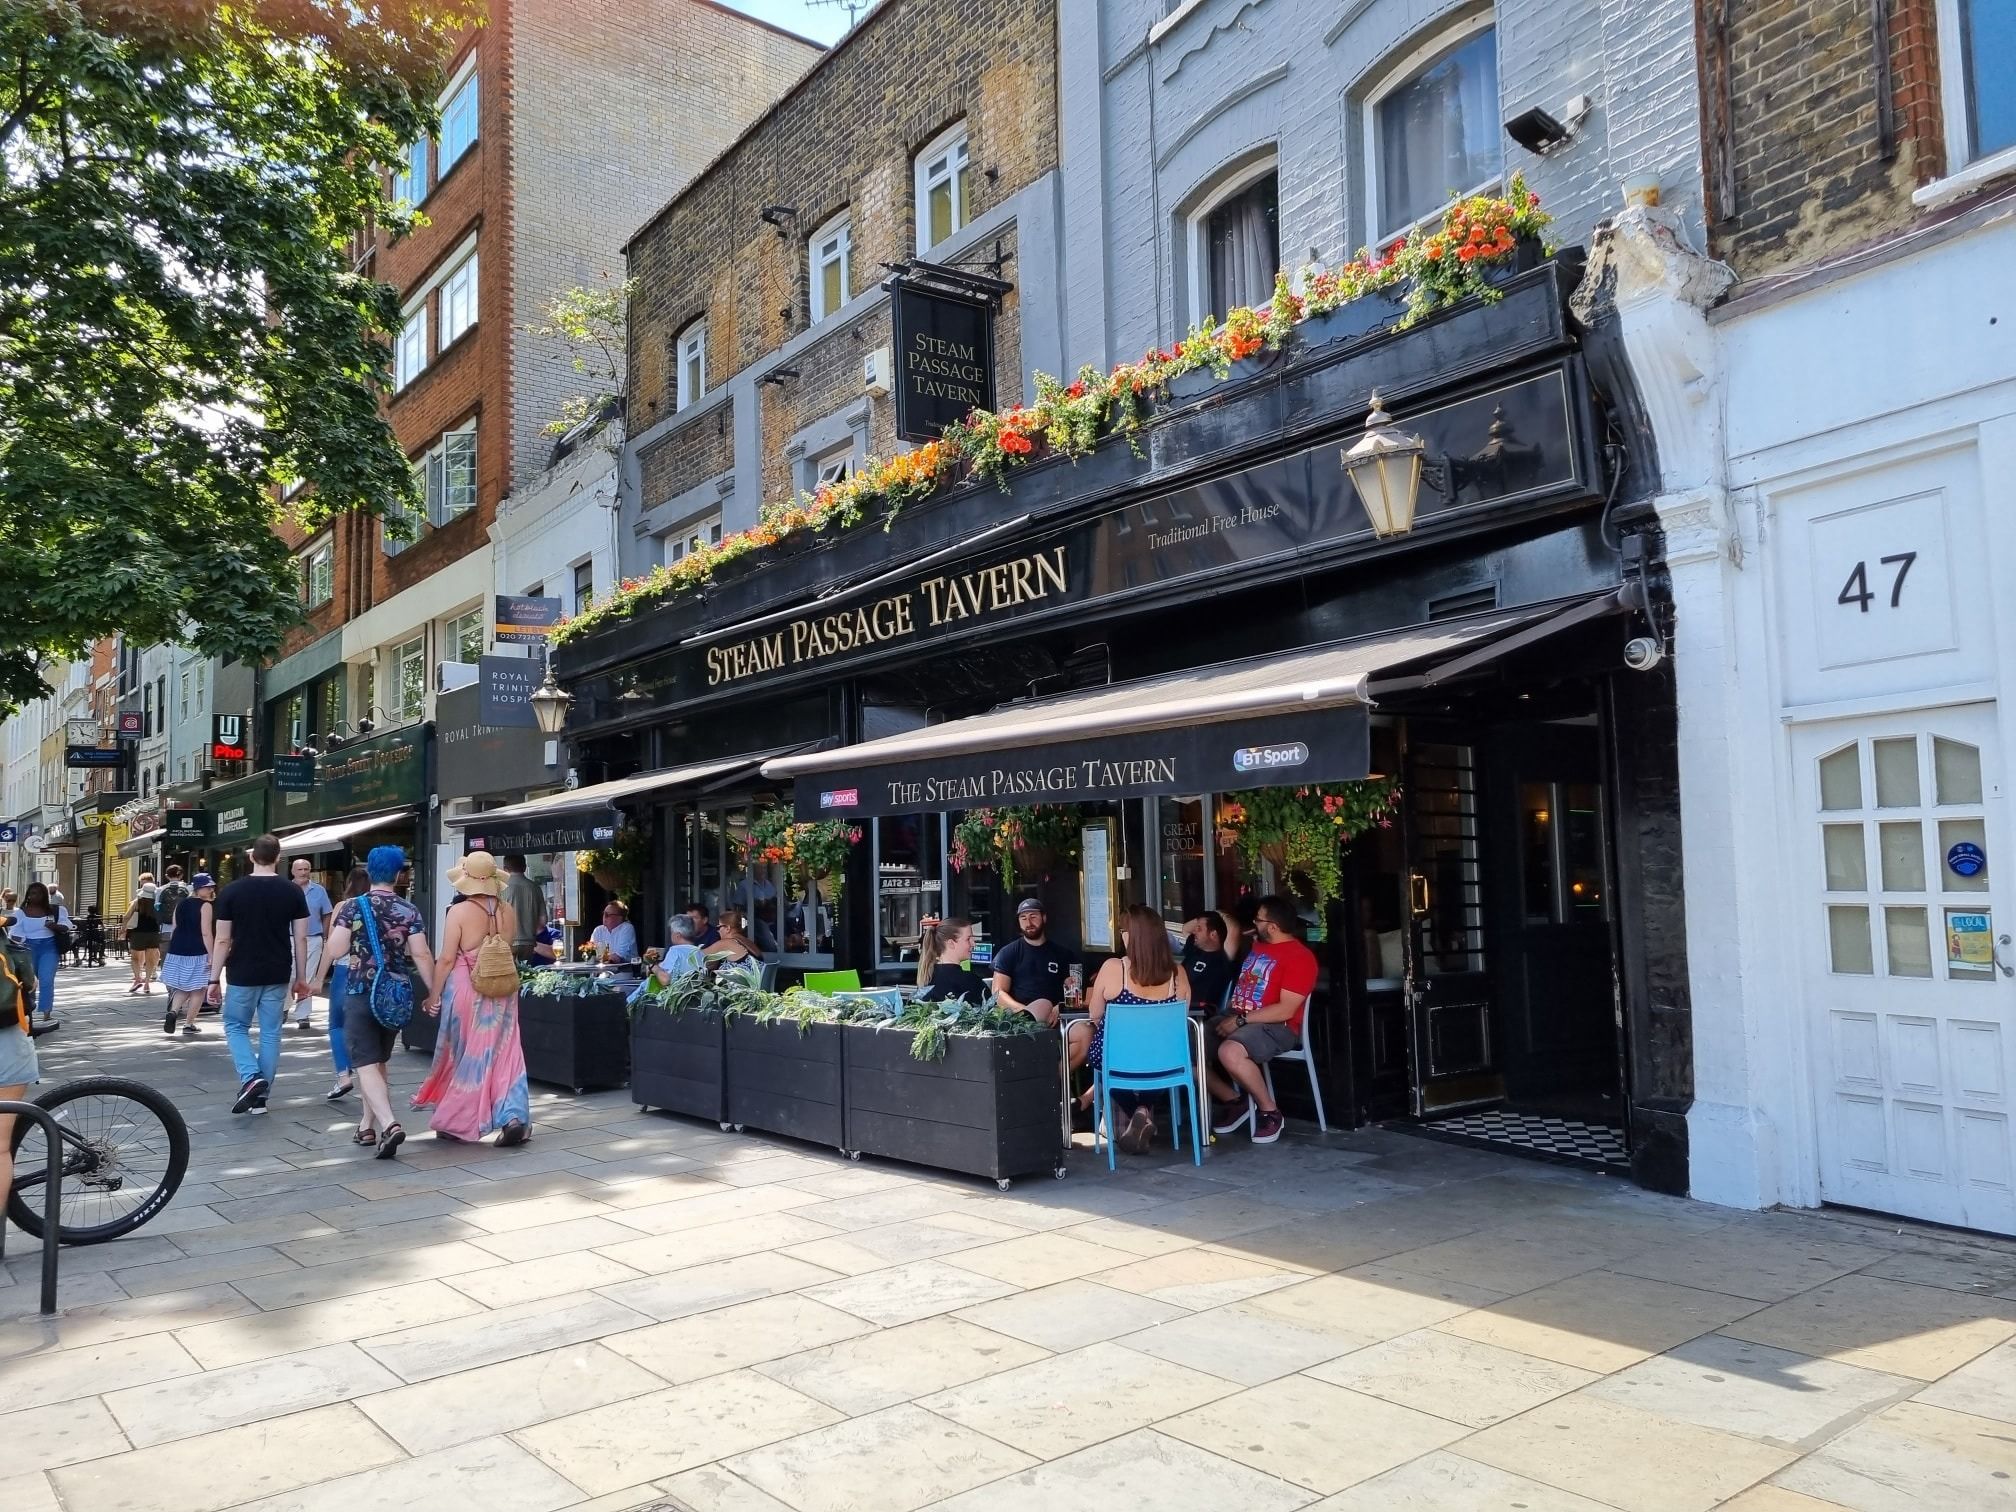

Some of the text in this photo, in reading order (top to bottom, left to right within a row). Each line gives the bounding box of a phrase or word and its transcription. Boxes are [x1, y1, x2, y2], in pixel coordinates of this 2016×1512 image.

[916, 333, 974, 361] STEAM
[908, 352, 984, 383] PASSAGE
[913, 376, 980, 404] TAVERN
[1148, 503, 1280, 550] Traditional Free House
[1838, 551, 1917, 613] 47
[707, 546, 1069, 686] STEAM PASSAGE TAVERN
[492, 671, 529, 682] ROYAL
[492, 683, 537, 692] TRINITY
[492, 694, 527, 704] HOSPI
[445, 727, 469, 743] ROYAL
[215, 745, 244, 758] Pho
[1242, 746, 1300, 766] BT Sport
[888, 757, 1176, 805] THE STEAM PASSAGE TAVERN
[822, 792, 856, 806] sky sports
[223, 807, 244, 821] MOUNTAIN
[1163, 823, 1197, 836] GREAT
[1166, 838, 1195, 851] FOOD
[133, 1188, 167, 1222] MAXXIS
